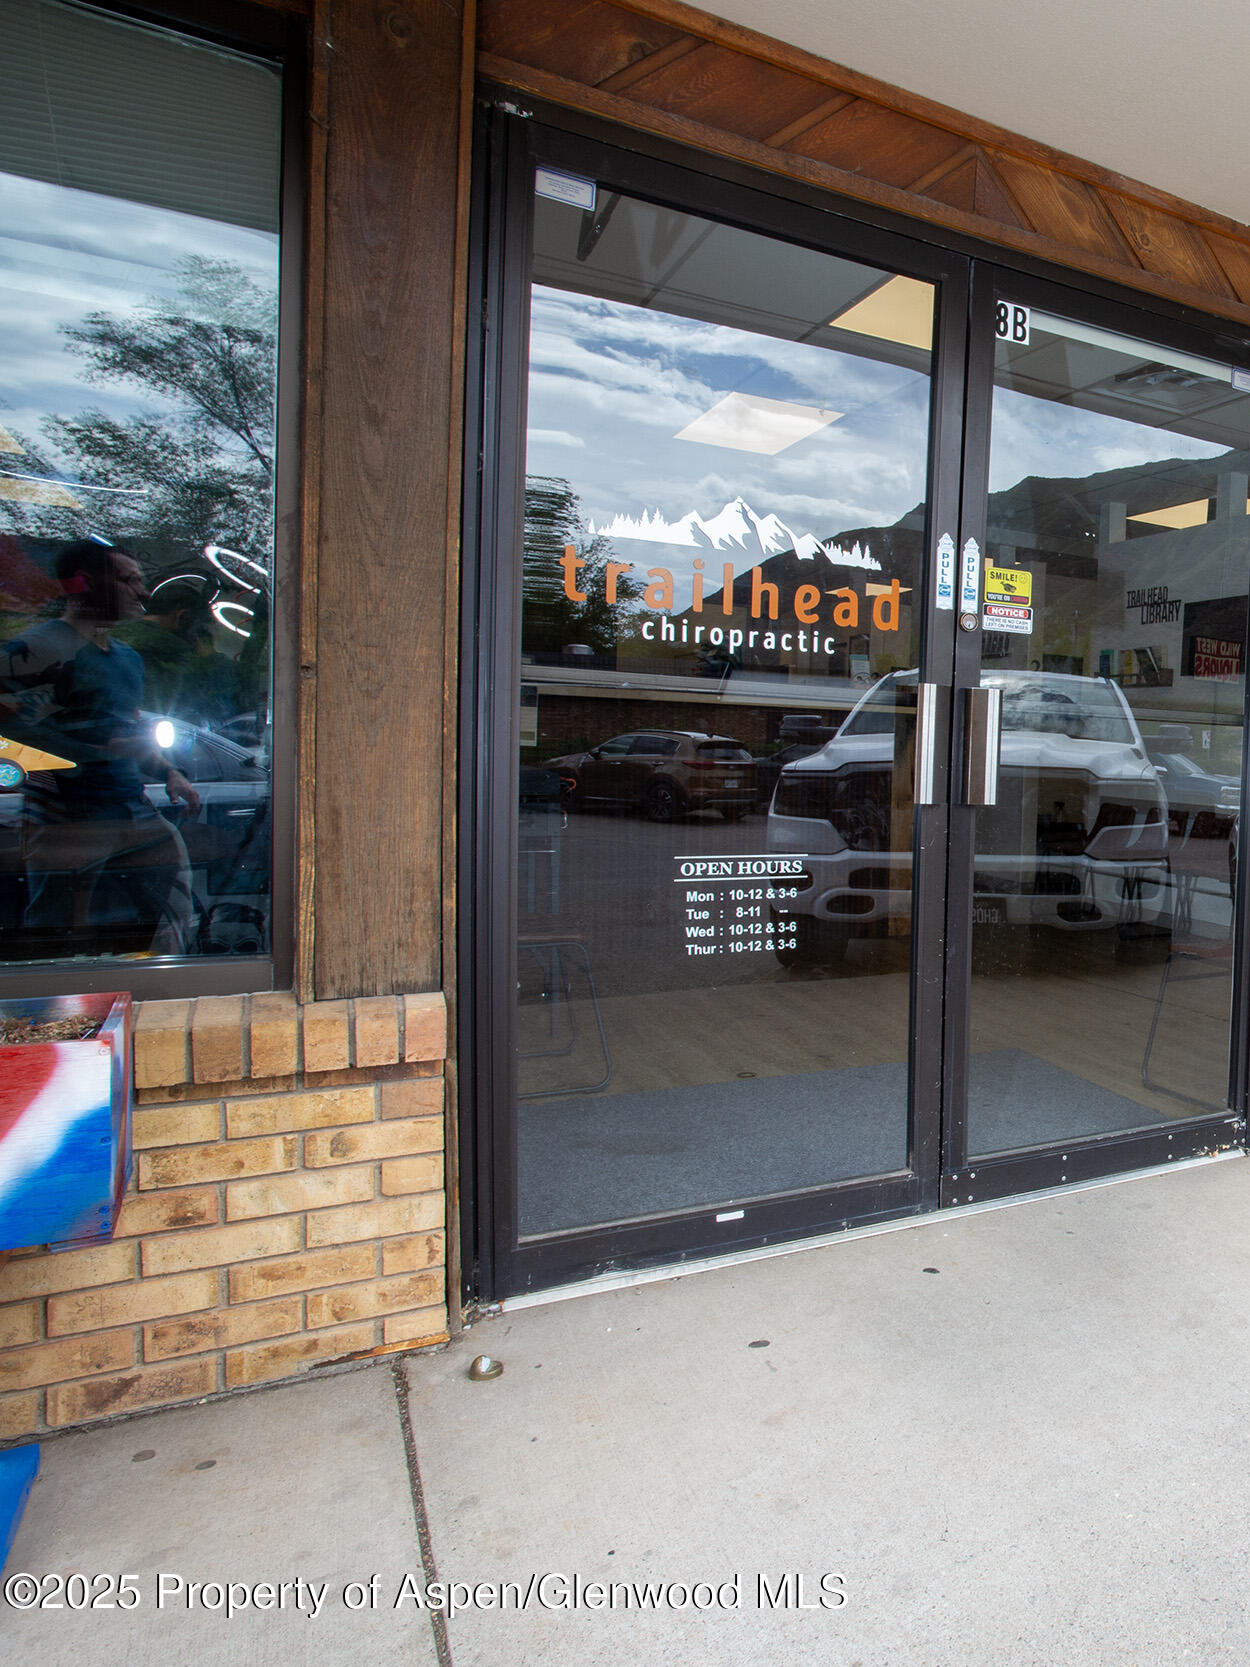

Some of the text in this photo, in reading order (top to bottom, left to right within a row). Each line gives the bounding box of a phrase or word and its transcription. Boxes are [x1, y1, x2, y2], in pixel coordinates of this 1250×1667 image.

[941, 553, 950, 583] PULL
[966, 557, 975, 588] PULL
[989, 571, 1018, 583] SMILE!
[558, 545, 901, 632] trailhead
[1126, 586, 1169, 607] TRAILHEAD
[991, 607, 1024, 618] NOTICE
[1141, 600, 1182, 625] LIBRARY
[641, 616, 836, 655] chiropractic
[680, 860, 803, 876] OPEN HOURS
[686, 891, 714, 902] Mon
[729, 888, 763, 901] 10-12
[766, 888, 775, 899] &
[778, 887, 798, 899] 3-6
[685, 908, 710, 920] Tue
[735, 905, 761, 918] 8-11
[685, 925, 715, 938] Wed
[728, 923, 763, 936] 10-12
[765, 922, 775, 933] &
[777, 921, 797, 933] 3-6
[685, 944, 717, 956] Thur
[728, 940, 762, 953] 10-12
[765, 939, 775, 950] &
[777, 938, 797, 950] 3-6
